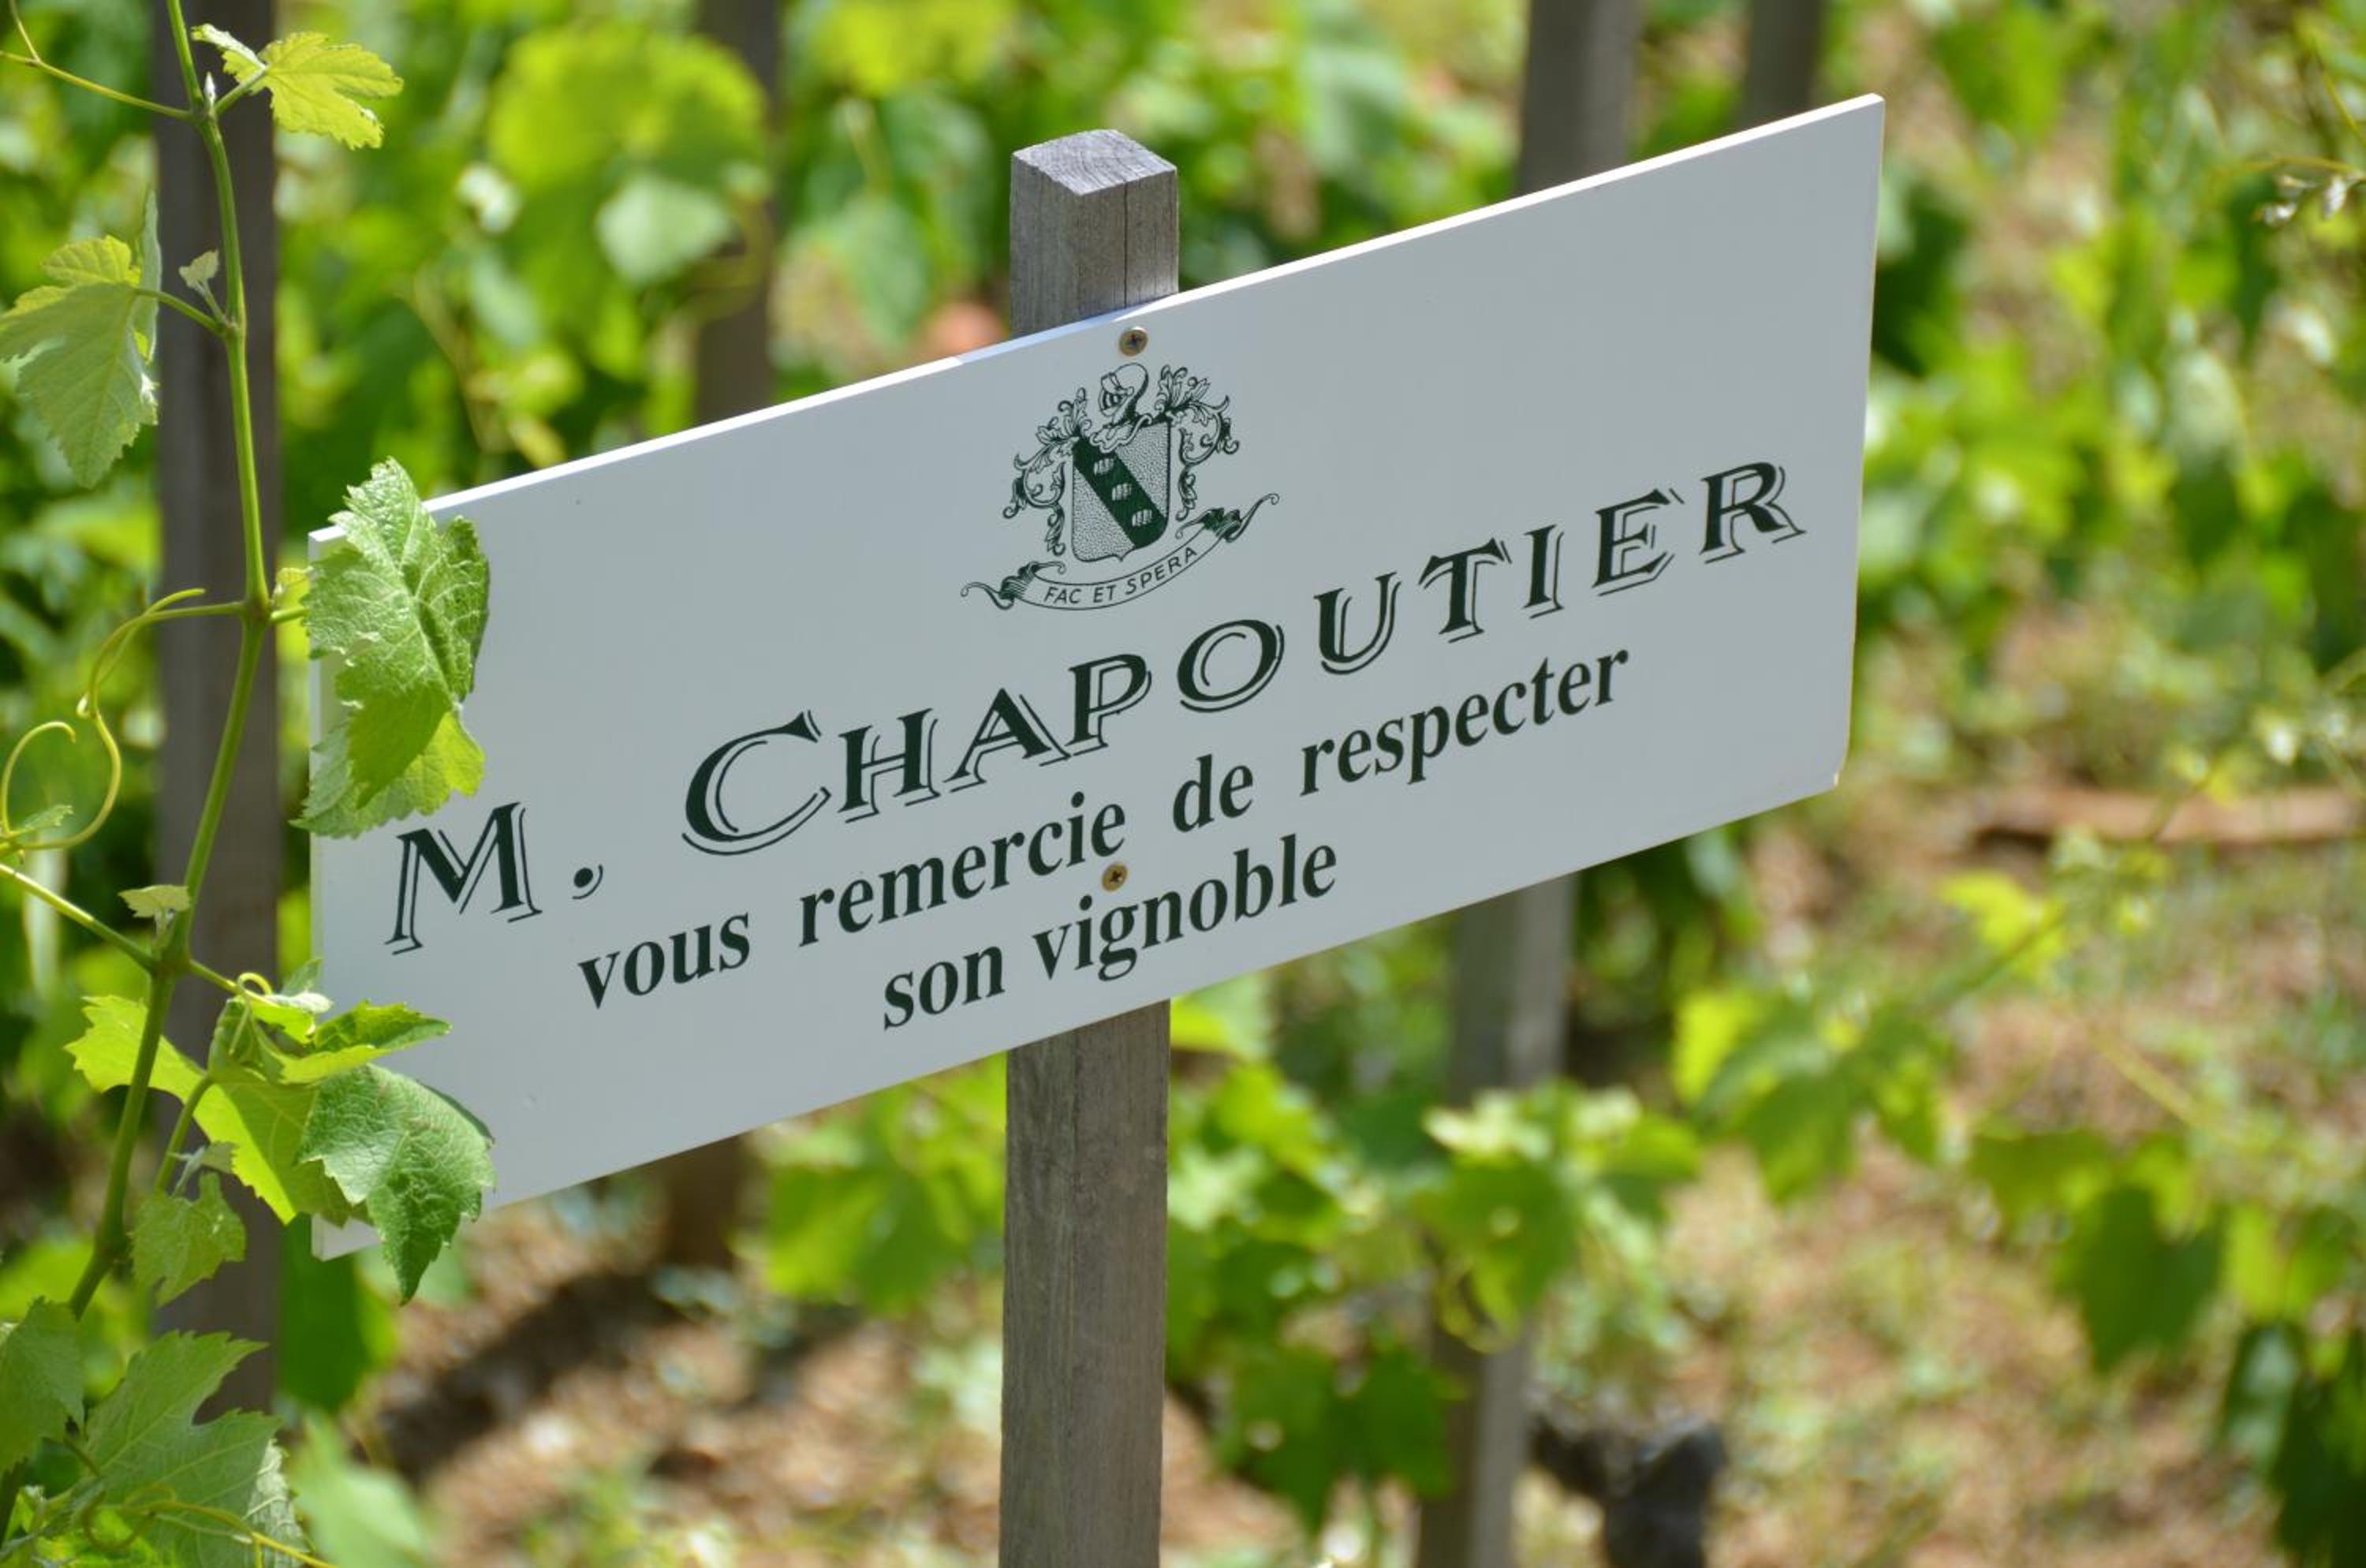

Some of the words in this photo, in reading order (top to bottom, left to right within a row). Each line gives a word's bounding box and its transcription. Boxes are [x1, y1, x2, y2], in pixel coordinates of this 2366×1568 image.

[384, 801, 603, 955] M.
[682, 461, 1807, 856] CHAPOUTIER
[1043, 585, 1081, 605] FAC
[1092, 584, 1117, 603] ET
[1125, 547, 1198, 596] SPERA
[577, 912, 751, 1010] vous
[798, 790, 1126, 947] remercie
[1172, 753, 1254, 833] de
[1300, 648, 1629, 797] respecter
[883, 946, 1006, 1030] son
[1032, 833, 1337, 983] vignoble
